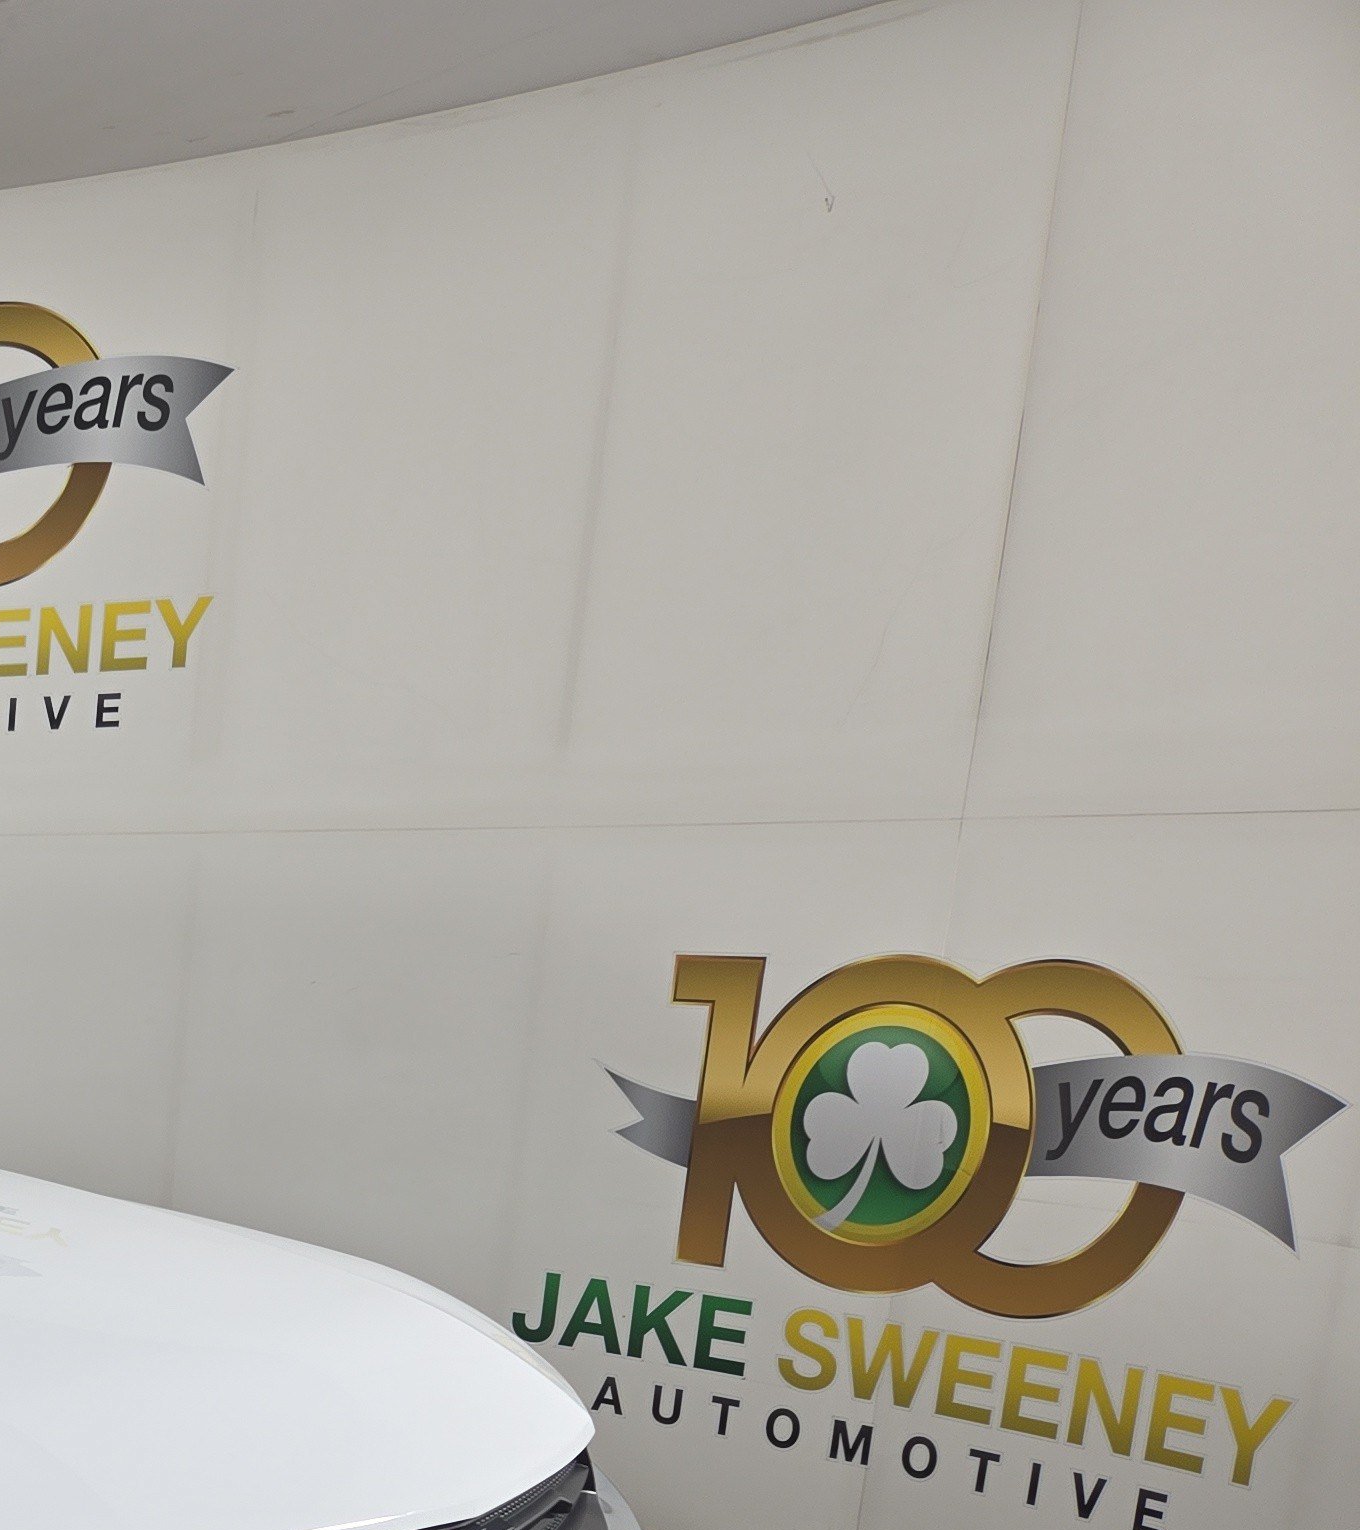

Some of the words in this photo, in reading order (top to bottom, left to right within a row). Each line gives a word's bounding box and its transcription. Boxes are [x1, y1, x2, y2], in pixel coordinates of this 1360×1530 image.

[1044, 1075, 1271, 1164] years
[511, 1271, 753, 1376] JAKE
[778, 1307, 1294, 1487] SWEENEY
